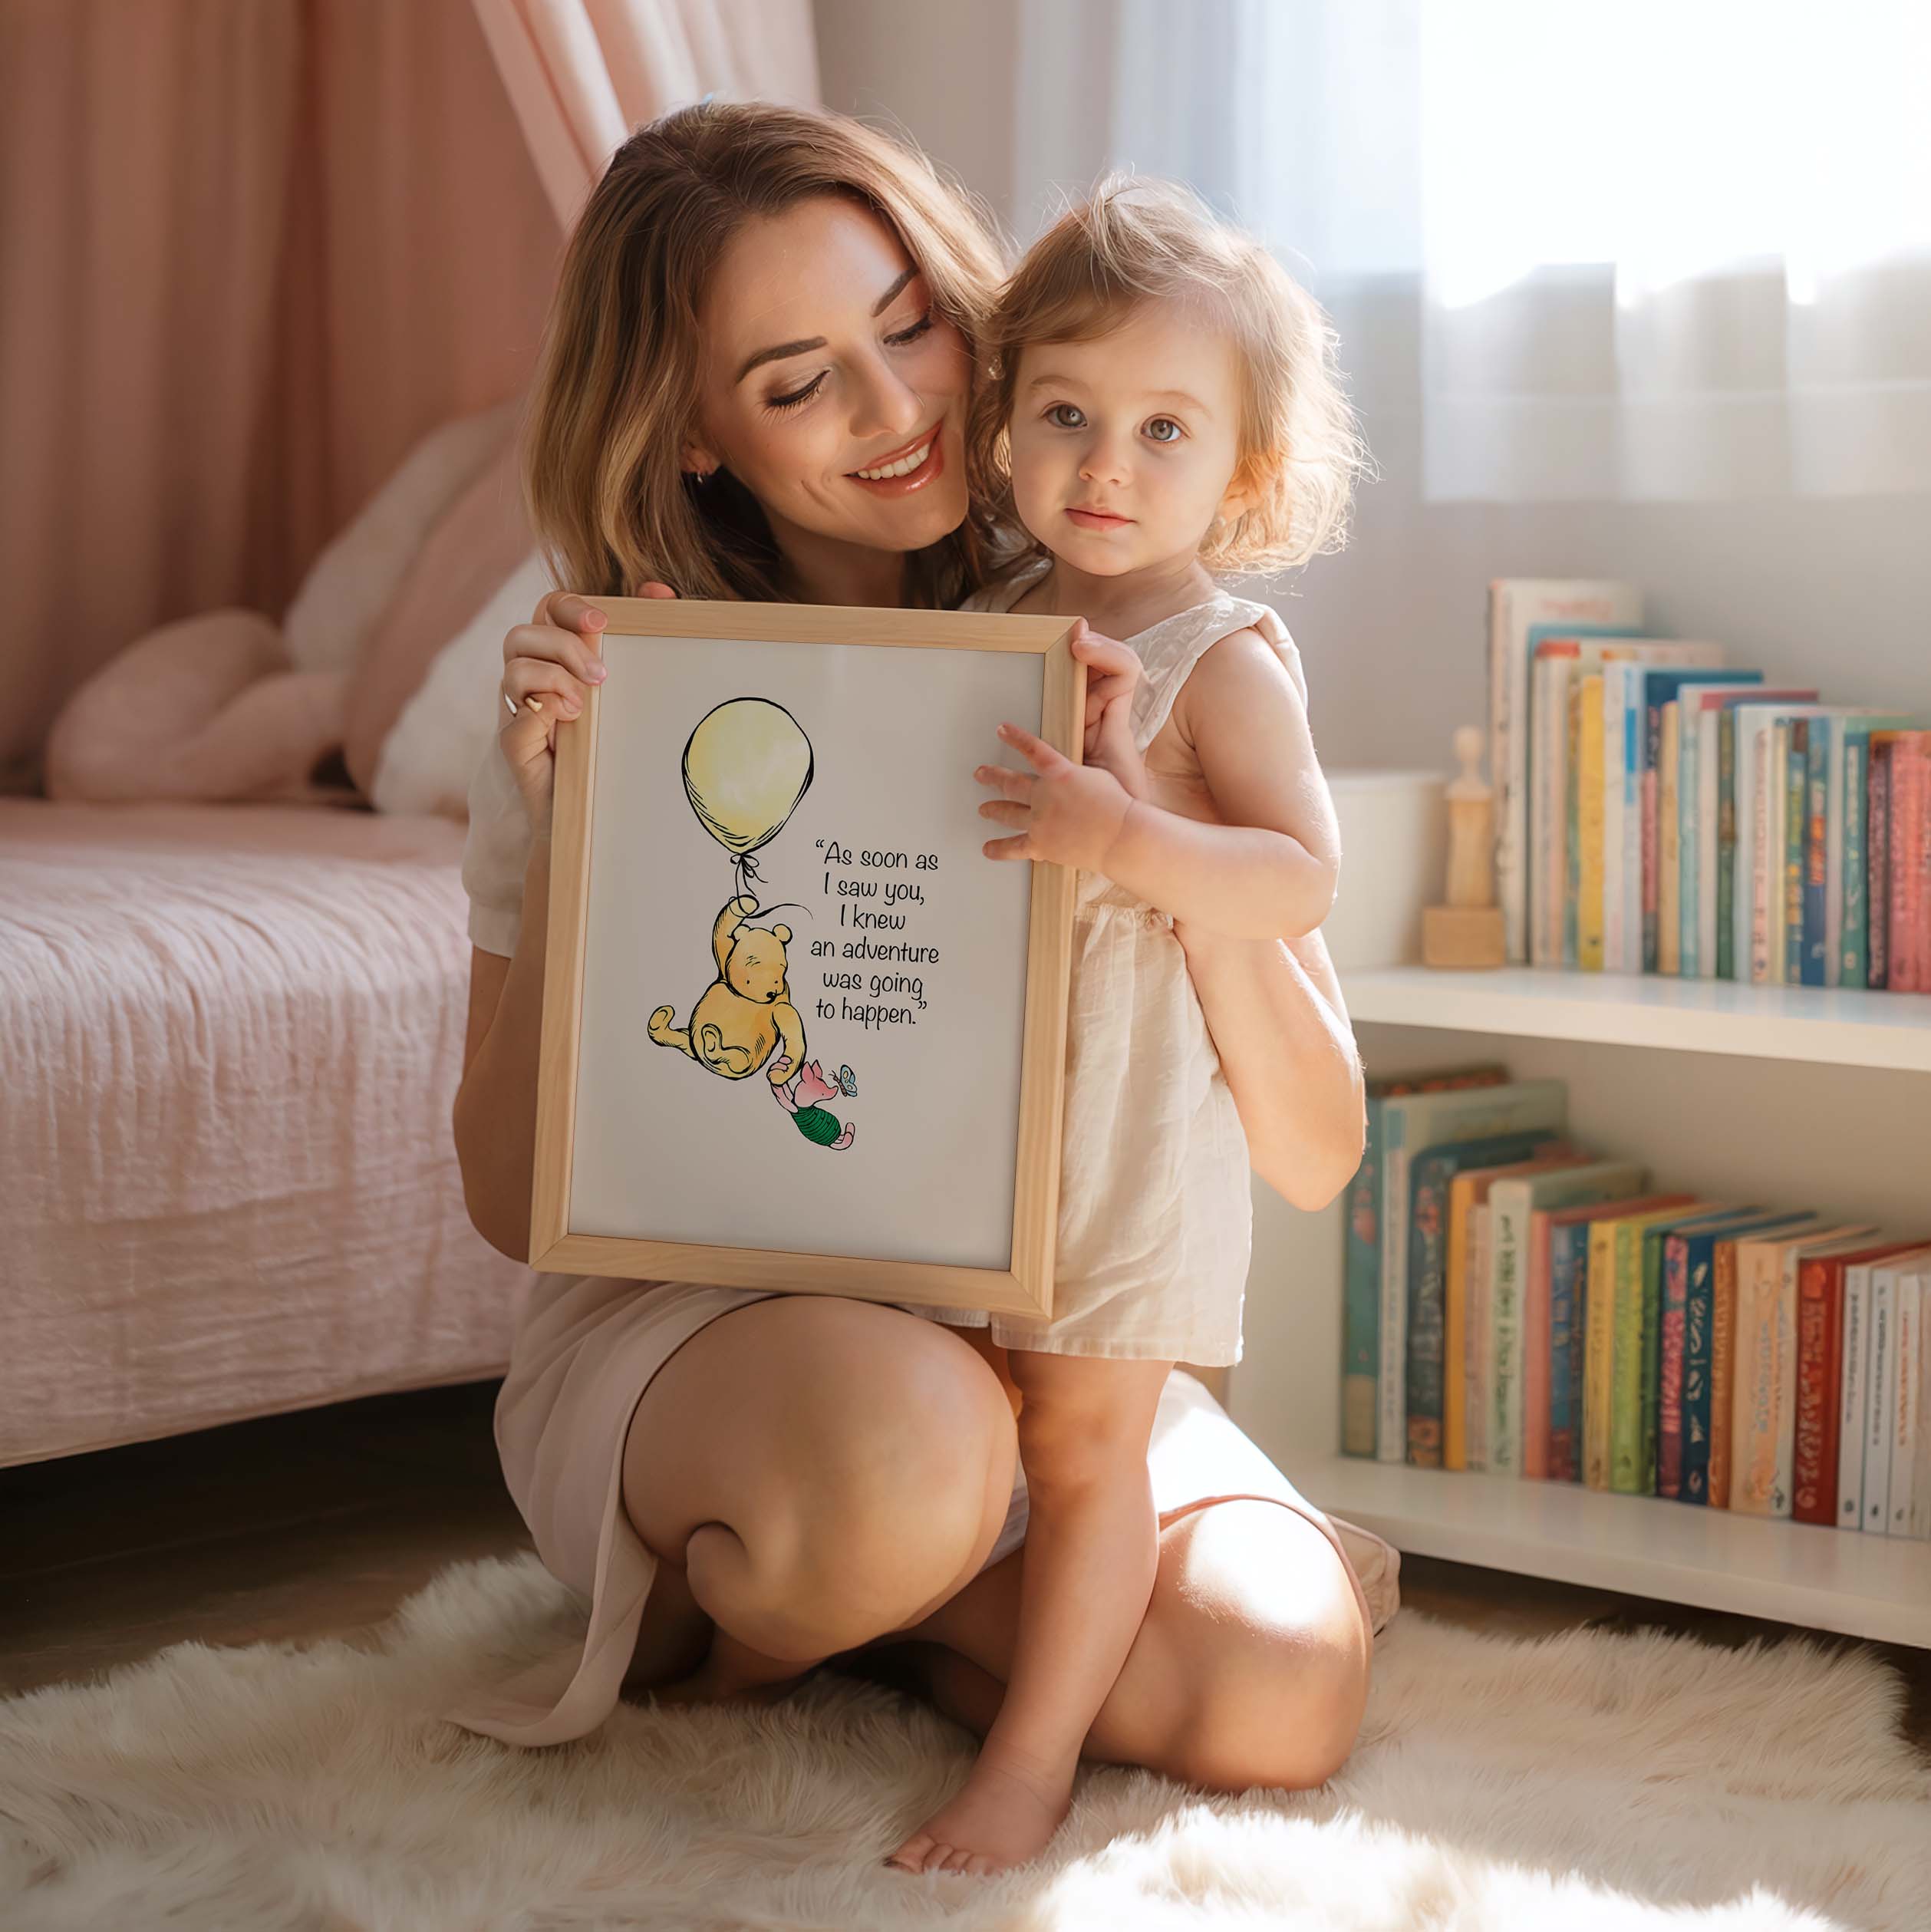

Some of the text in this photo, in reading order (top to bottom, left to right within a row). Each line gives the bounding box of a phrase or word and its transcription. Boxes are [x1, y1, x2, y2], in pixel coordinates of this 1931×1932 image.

[816, 839, 938, 871] “As soon as
[824, 872, 924, 906] I saw you,
[840, 903, 906, 930] I knew
[810, 935, 939, 964] an adventure
[822, 971, 924, 1001] was going
[816, 996, 928, 1031] to happen.”
